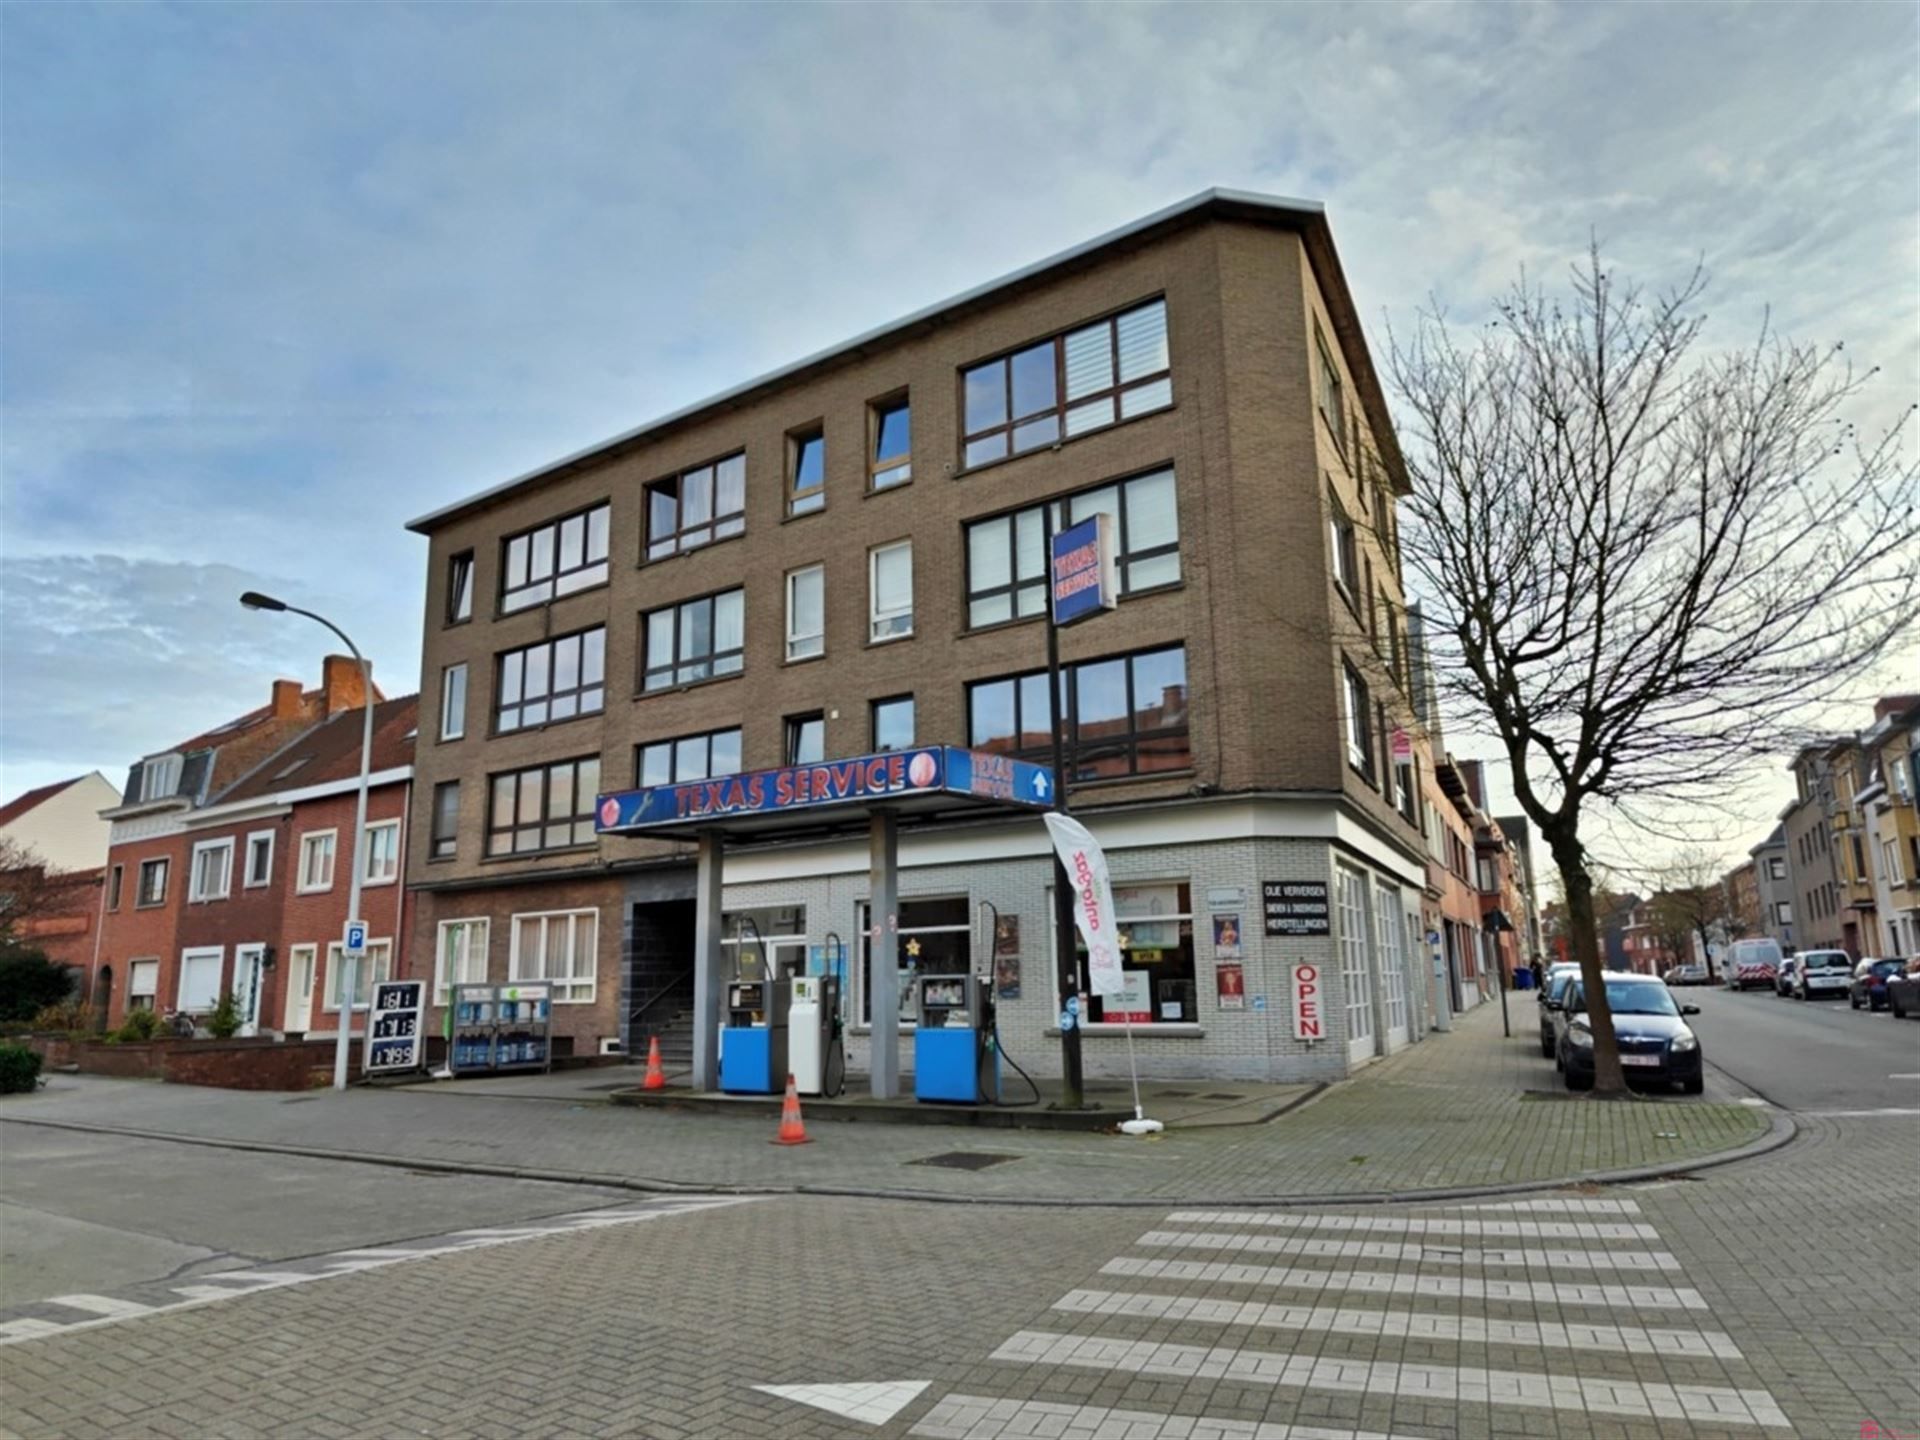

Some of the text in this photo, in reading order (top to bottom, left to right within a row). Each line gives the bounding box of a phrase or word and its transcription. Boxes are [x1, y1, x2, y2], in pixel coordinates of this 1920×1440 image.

[675, 756, 906, 817] TEXAS SERVICE
[351, 930, 362, 947] P
[1296, 965, 1320, 1036] OPEN
